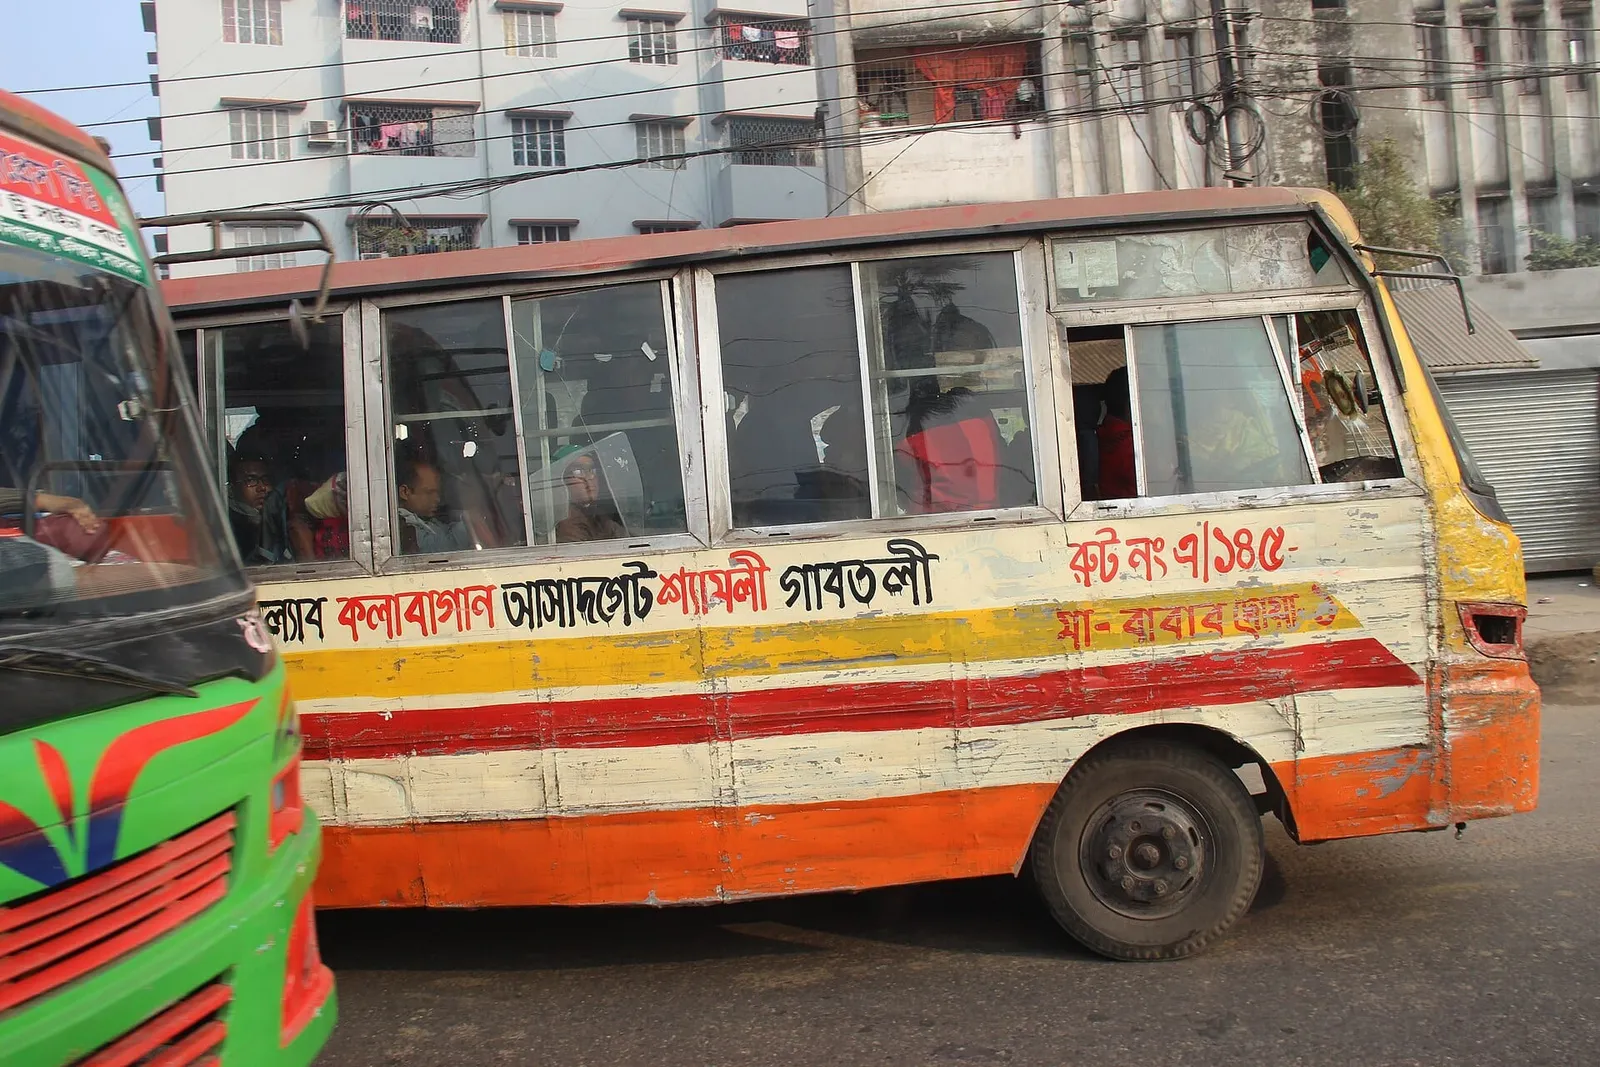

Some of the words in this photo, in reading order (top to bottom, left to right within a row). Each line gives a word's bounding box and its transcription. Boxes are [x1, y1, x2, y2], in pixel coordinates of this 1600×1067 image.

[335, 585, 497, 642] কলাবাগান
[500, 561, 658, 631] আসাদগেট
[656, 549, 771, 616] শ্যামলী
[779, 538, 940, 613] গাবতলী
[1068, 527, 1121, 588] রুট
[1125, 537, 1168, 585] নং
